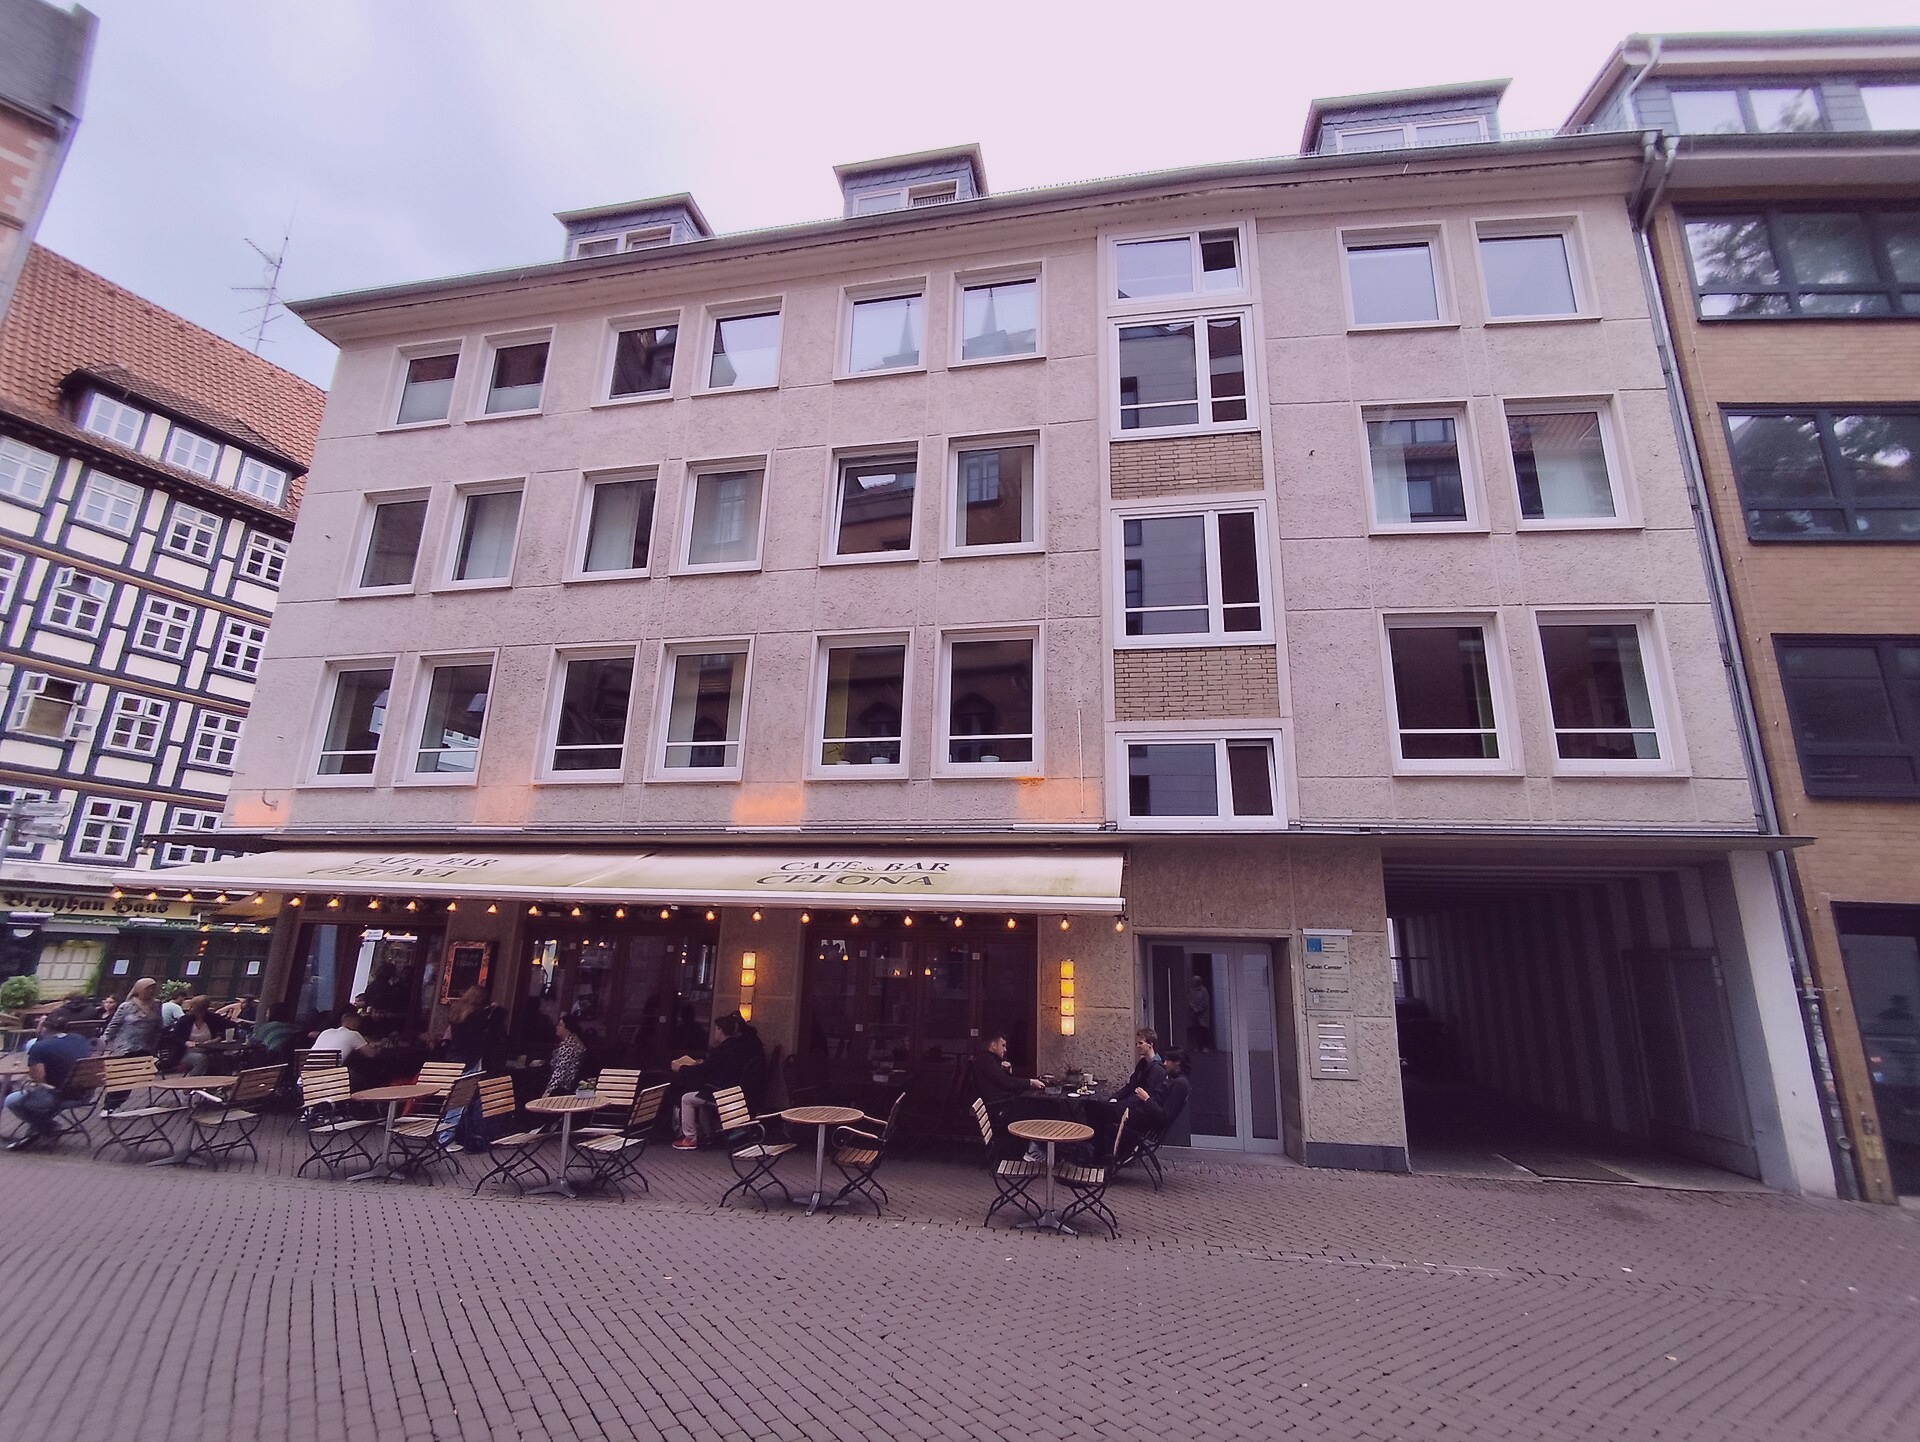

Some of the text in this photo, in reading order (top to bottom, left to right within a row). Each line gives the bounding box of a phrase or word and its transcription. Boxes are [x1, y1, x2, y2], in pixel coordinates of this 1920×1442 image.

[884, 861, 950, 872] BAR
[756, 874, 933, 886] CELONA
[3, 892, 169, 914] Broyhan Haus
